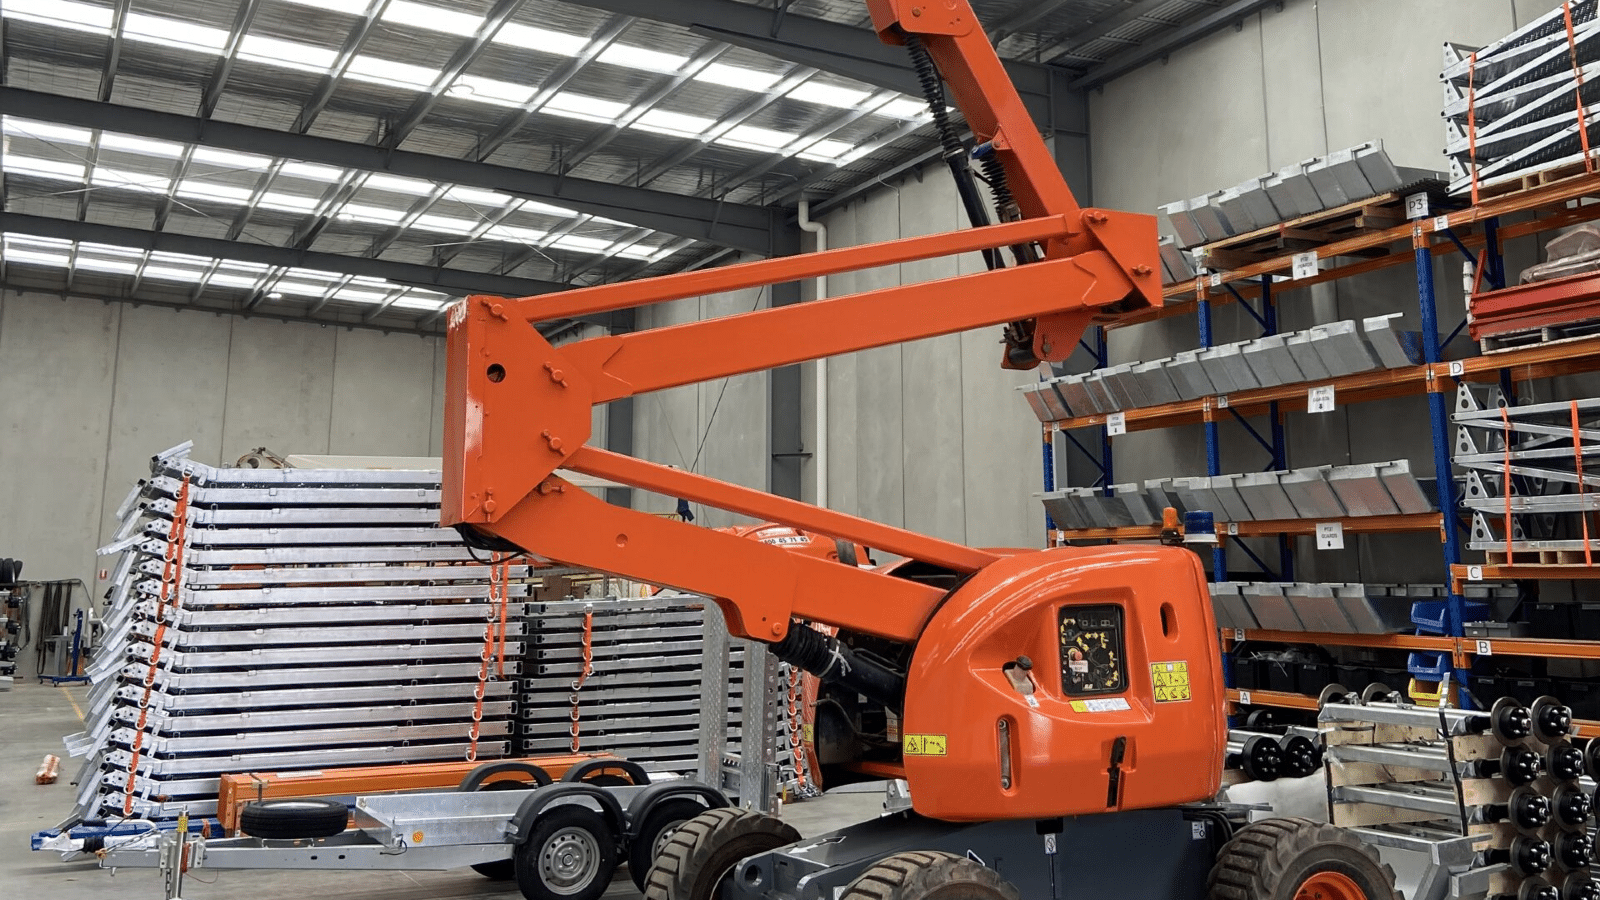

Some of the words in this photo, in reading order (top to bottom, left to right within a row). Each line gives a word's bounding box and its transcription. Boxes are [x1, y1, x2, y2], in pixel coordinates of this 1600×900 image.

[1409, 199, 1423, 212] P3
[1453, 362, 1462, 374] D
[1230, 523, 1237, 533] C
[1470, 566, 1479, 579] C
[1236, 629, 1243, 639] B
[1479, 641, 1488, 653] B
[1242, 692, 1249, 703] A
